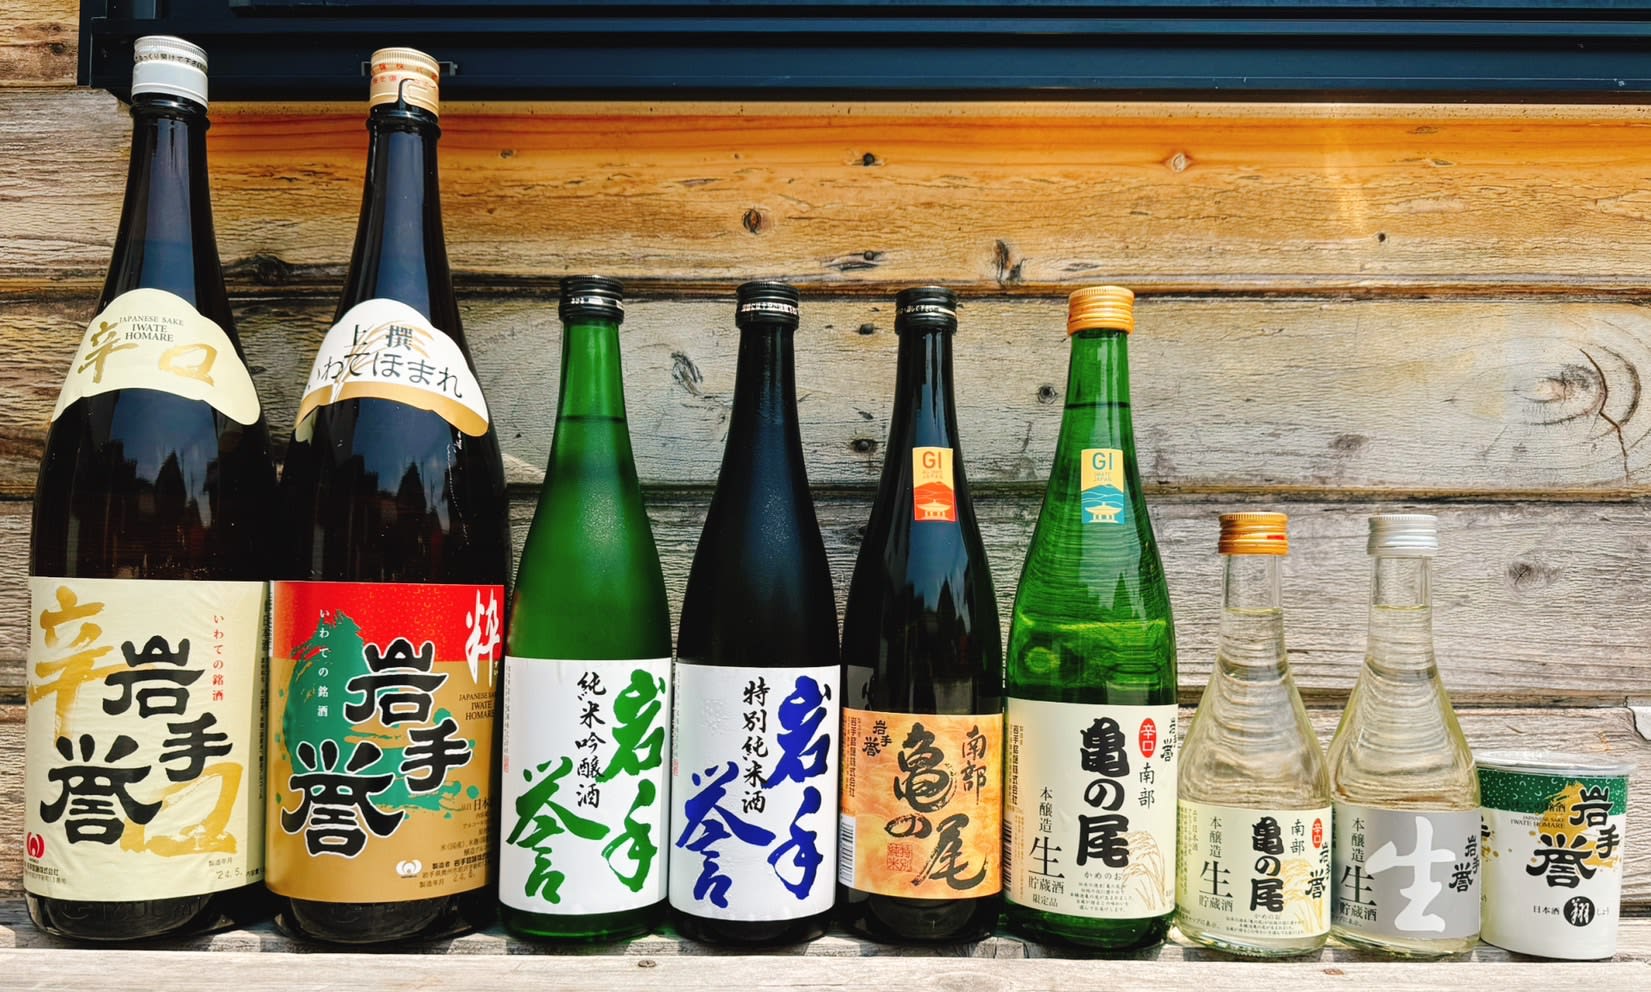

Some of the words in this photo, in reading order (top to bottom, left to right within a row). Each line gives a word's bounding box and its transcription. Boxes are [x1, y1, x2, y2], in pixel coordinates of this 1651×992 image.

[119, 315, 159, 323] JAPANESE
[162, 317, 184, 326] SAKE
[125, 332, 174, 342] HOMARE
[132, 323, 168, 333] IWATE
[344, 324, 413, 350] 上撰
[922, 451, 942, 469] GI
[1092, 451, 1113, 470] GI
[211, 614, 225, 702] いわての銘酒
[317, 608, 331, 718] いわての銘酒
[575, 671, 607, 808] 純米吟醸酒
[741, 676, 770, 814] 特別純米酒
[1140, 722, 1157, 752] 辛口
[1076, 717, 1130, 868] 亀の尾
[1138, 762, 1155, 808] 南部
[1039, 786, 1053, 833] 本醸造
[1028, 836, 1065, 879] 生
[1209, 816, 1222, 858] 本醸造
[1290, 819, 1305, 856] 南部
[1352, 817, 1365, 863] 本醸造
[1028, 875, 1064, 894] 貯蔵酒
[1199, 860, 1233, 898] 生
[1250, 816, 1284, 912] 亀の尾
[1364, 816, 1456, 933] 生
[1340, 865, 1377, 906] 生
[1533, 905, 1559, 915] 日本酒
